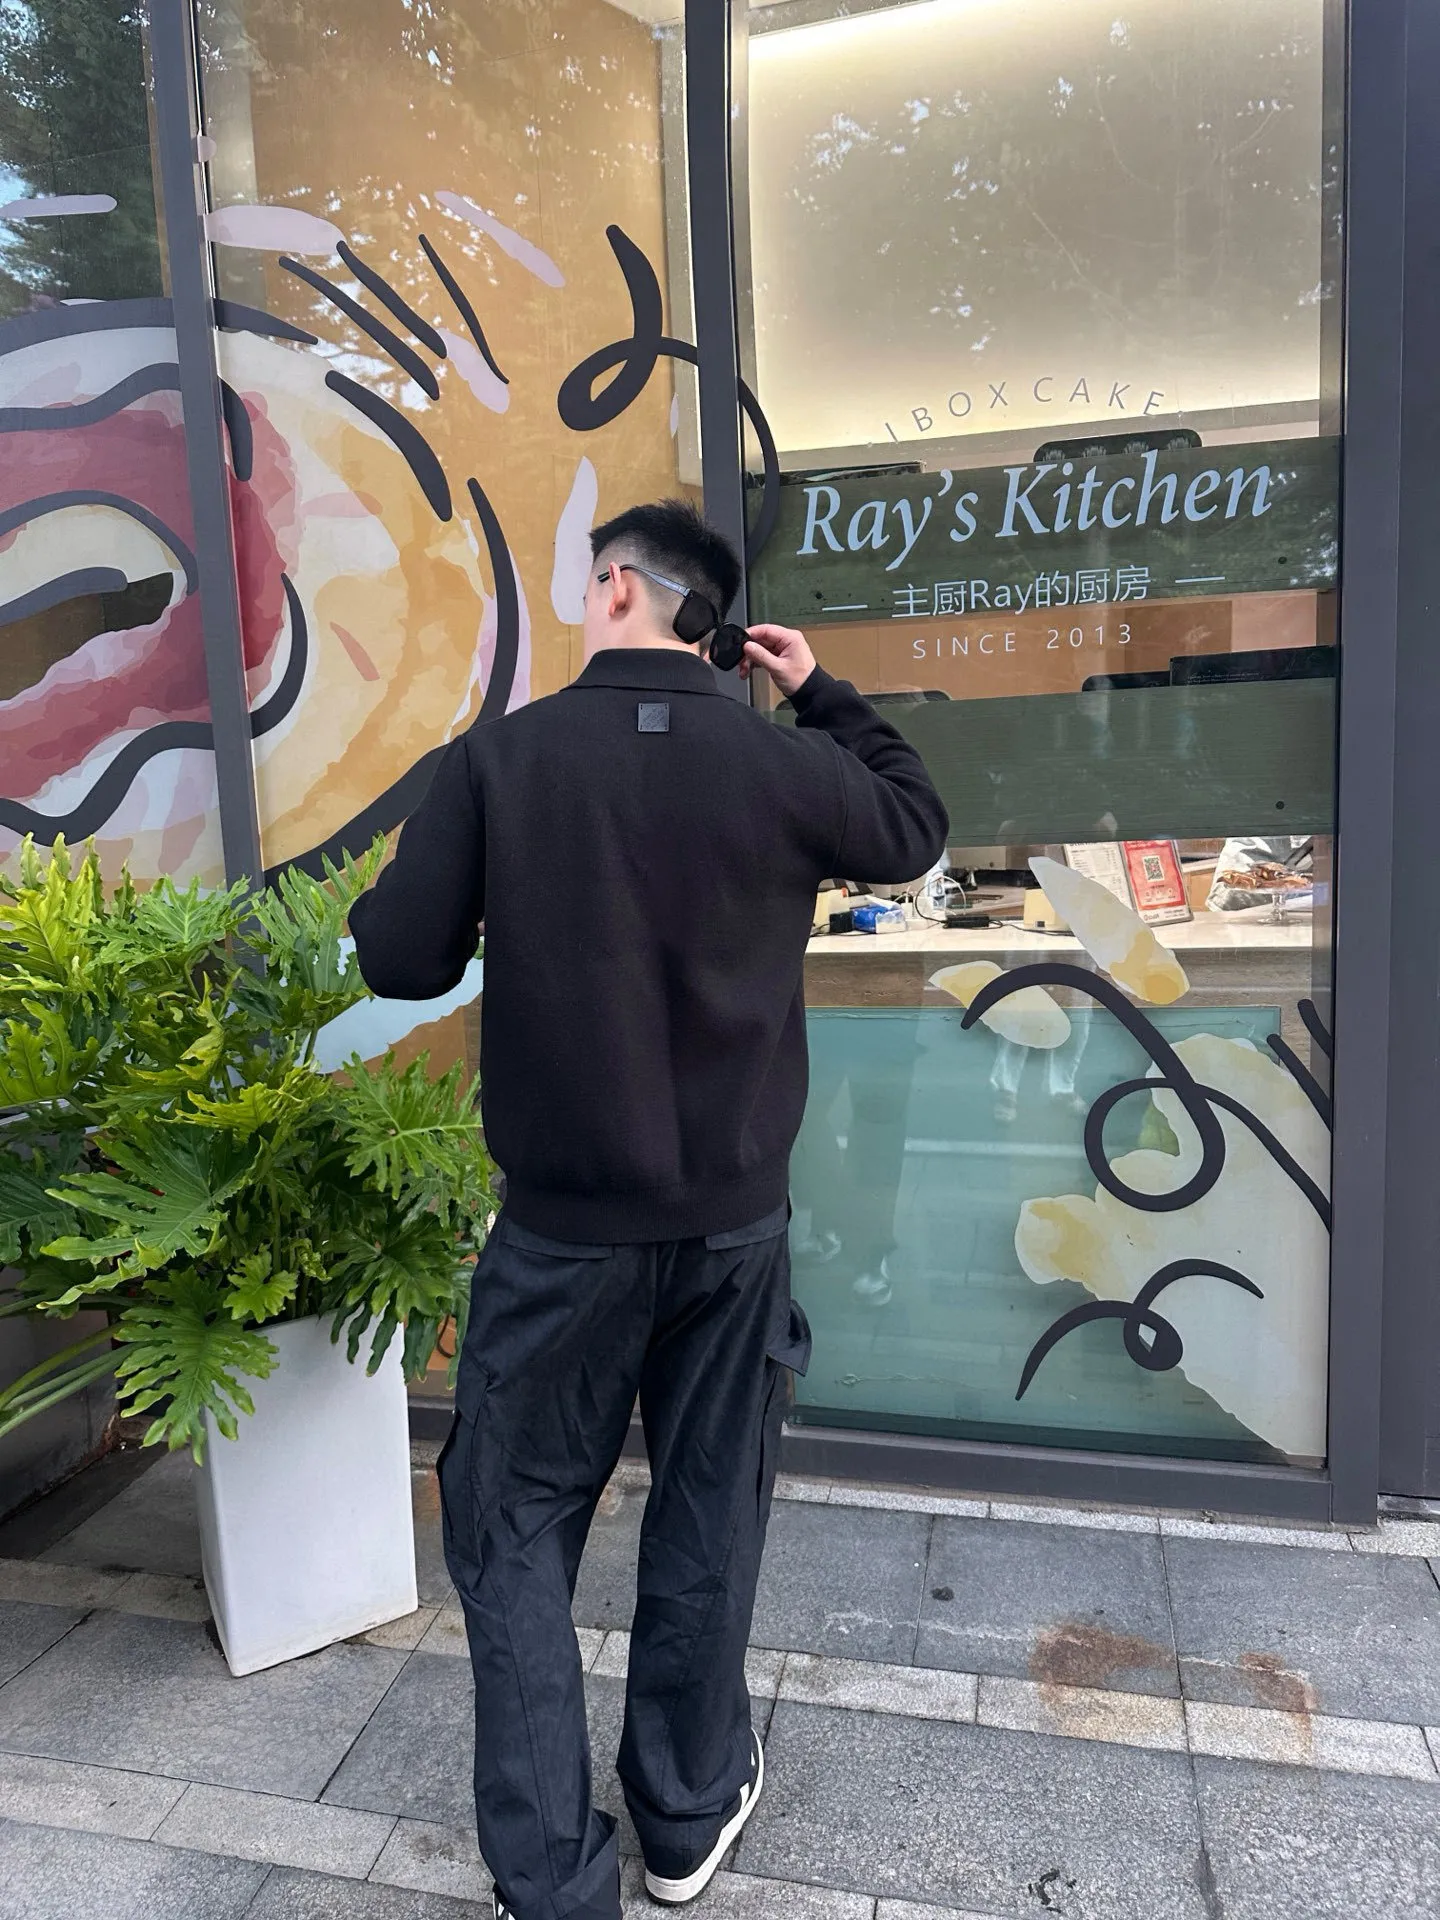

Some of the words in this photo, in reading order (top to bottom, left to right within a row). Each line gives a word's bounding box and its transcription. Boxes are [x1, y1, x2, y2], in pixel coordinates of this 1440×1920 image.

[1033, 376, 1164, 416] CAKE
[796, 466, 979, 572] Ray's
[995, 448, 1272, 538] Kitchen
[891, 564, 1152, 619] 主厨Ray的厨房
[912, 631, 1017, 660] SINCE
[1046, 623, 1132, 651] 2013
